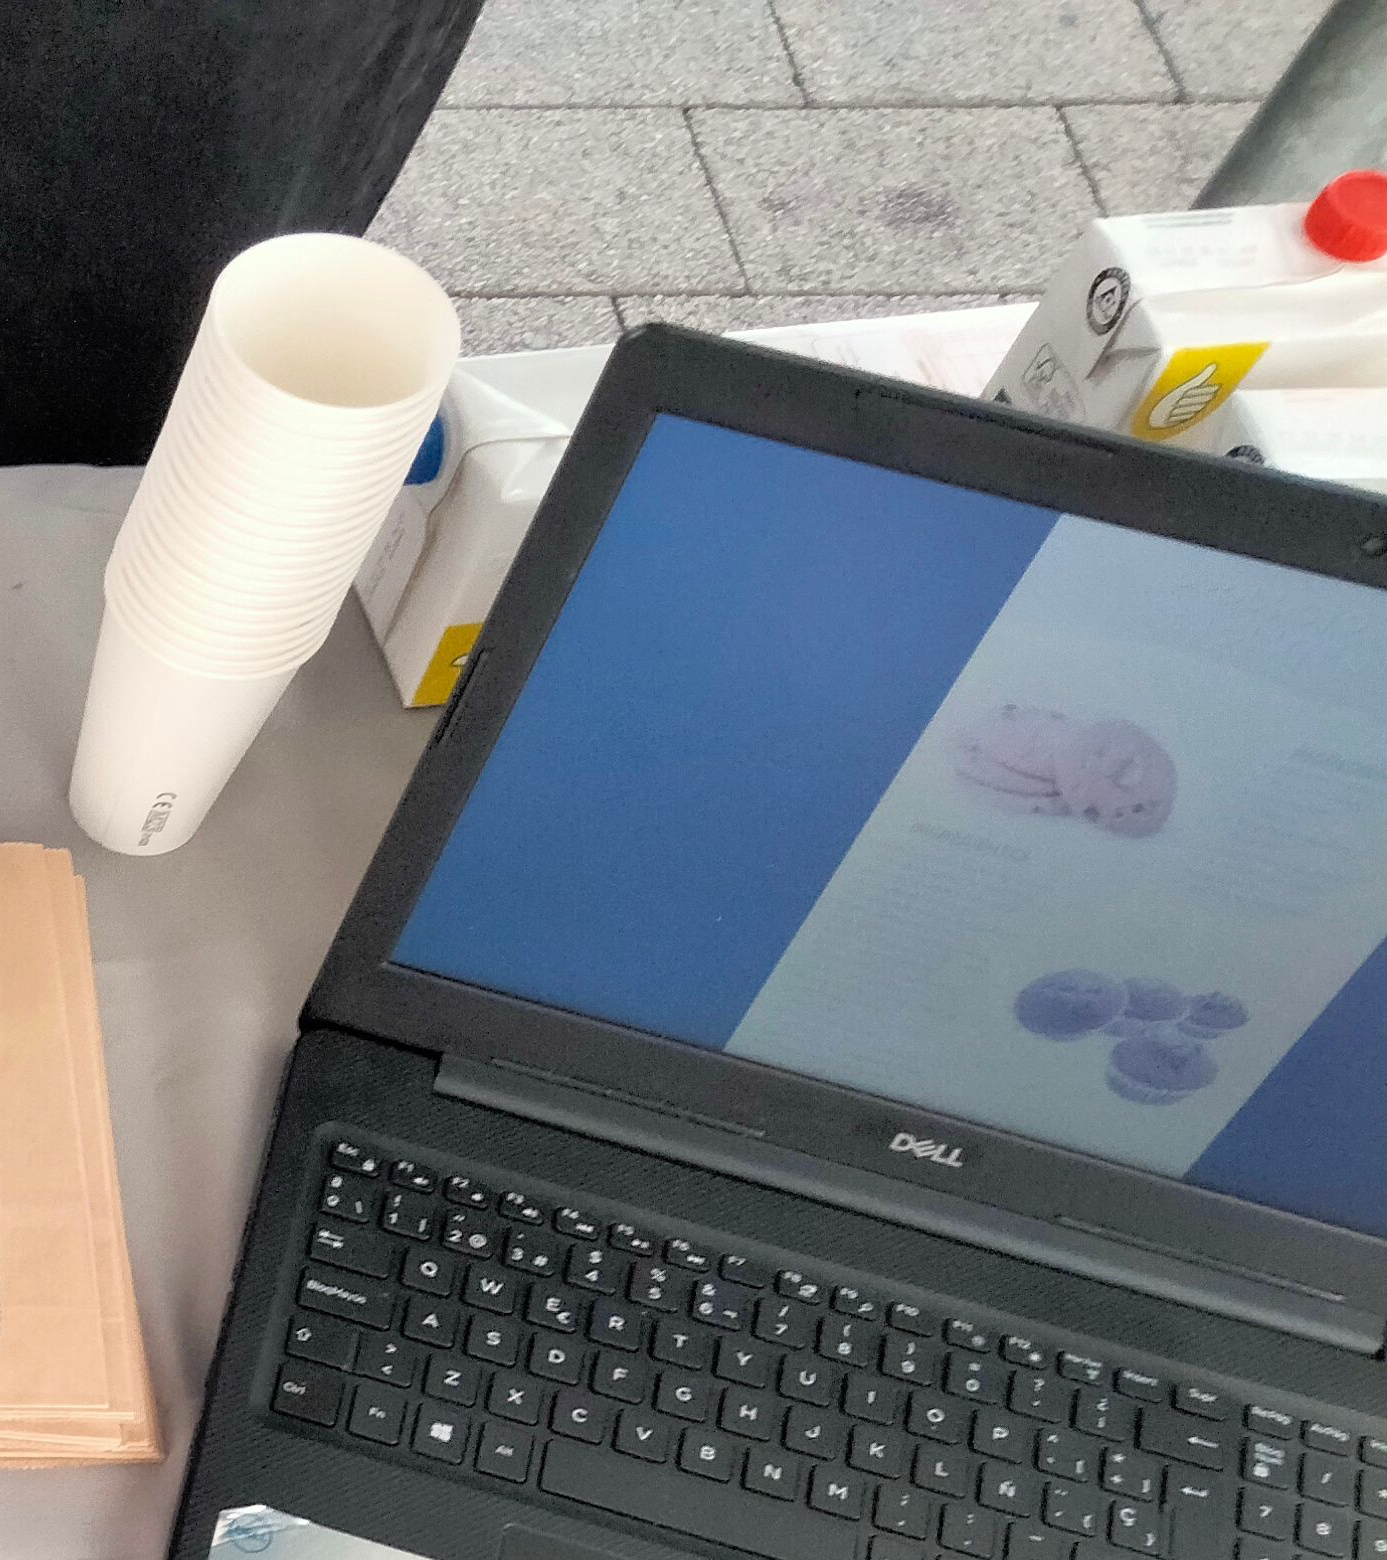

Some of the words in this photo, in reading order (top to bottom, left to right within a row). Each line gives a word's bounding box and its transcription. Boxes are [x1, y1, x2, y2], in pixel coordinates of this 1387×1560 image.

[889, 1132, 964, 1168] DELL
[480, 1277, 504, 1295] W
[545, 1297, 561, 1312] E
[421, 1313, 439, 1328] A
[608, 1315, 625, 1331] R
[486, 1331, 501, 1346] S
[672, 1334, 689, 1348] T
[548, 1349, 566, 1364] D
[736, 1351, 752, 1366] Y
[444, 1370, 461, 1386] Z
[612, 1367, 628, 1381] F
[507, 1388, 525, 1405] X
[571, 1408, 588, 1423] C
[739, 1404, 758, 1421] H
[636, 1426, 653, 1441] V
[700, 1445, 716, 1461] B
[869, 1442, 885, 1458] K
[763, 1464, 782, 1480] N
[828, 1483, 848, 1500] M
